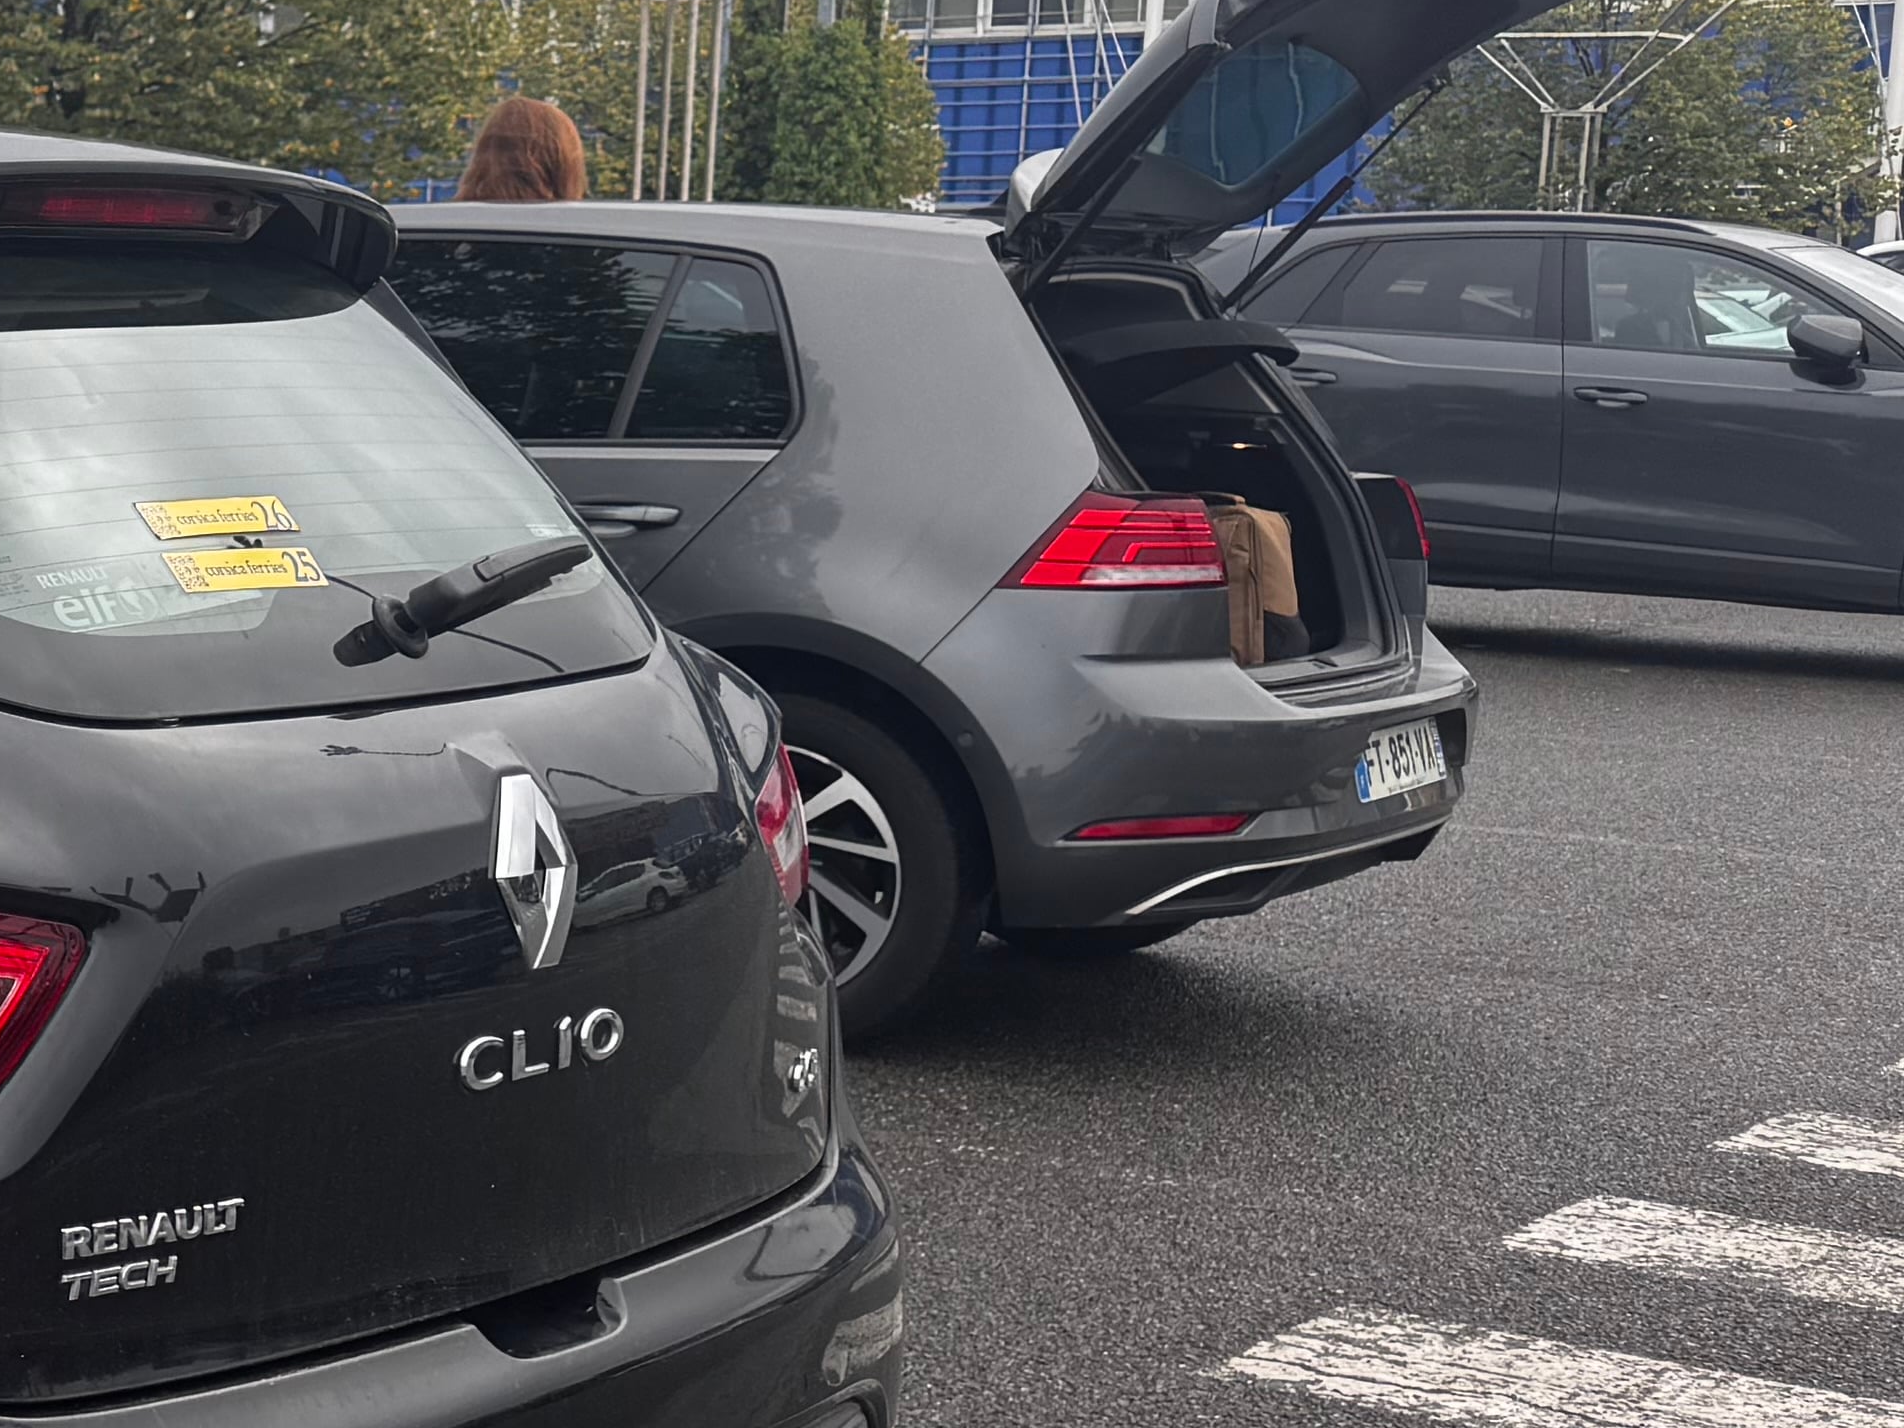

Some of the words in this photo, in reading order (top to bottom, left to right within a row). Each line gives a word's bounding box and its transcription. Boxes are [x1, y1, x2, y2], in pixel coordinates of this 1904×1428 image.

[250, 500, 293, 531] 26
[35, 565, 110, 589] RENAULT
[281, 550, 321, 582] 25
[53, 584, 116, 628] elf
[459, 1008, 625, 1091] CLIO
[60, 1198, 245, 1260] RENAULT
[60, 1255, 178, 1301] TECH
